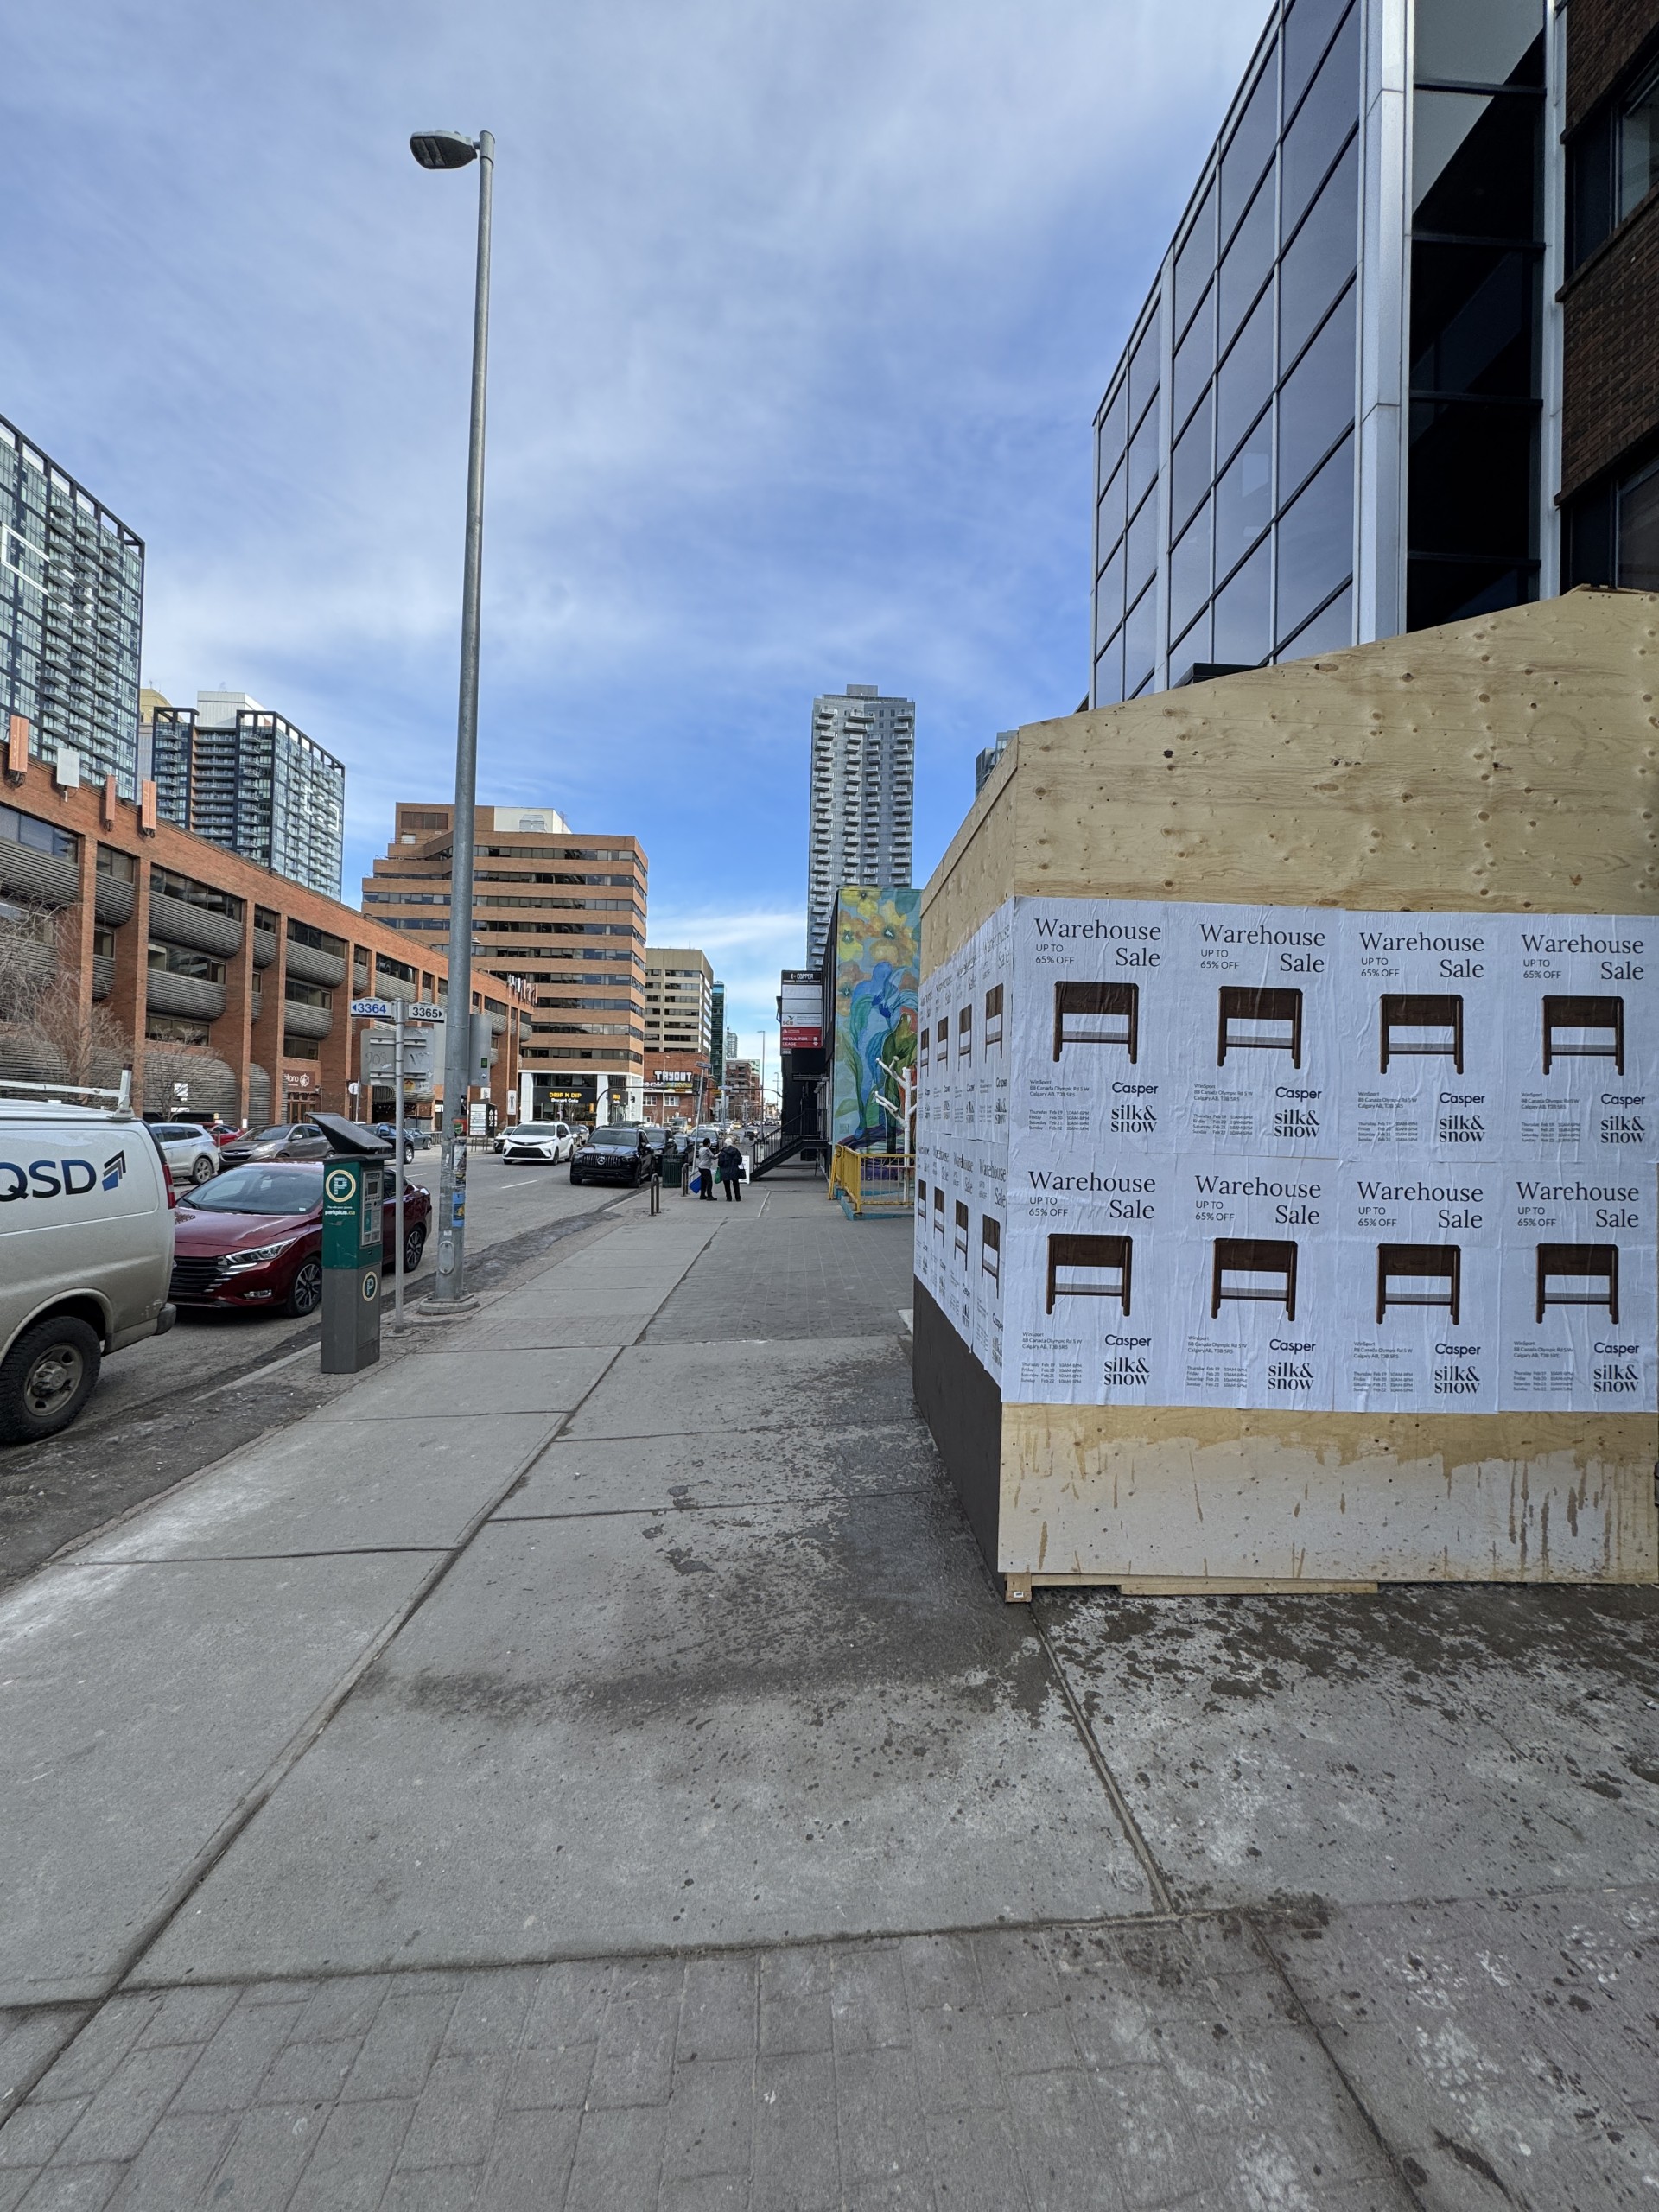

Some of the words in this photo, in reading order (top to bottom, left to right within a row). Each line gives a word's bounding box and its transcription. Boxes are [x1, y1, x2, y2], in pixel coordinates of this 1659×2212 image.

[1034, 918, 1161, 940] Warehouse
[1199, 924, 1325, 946] Warehouse
[1359, 932, 1484, 951] Warehouse
[1521, 934, 1643, 954] Warehouse
[1116, 947, 1160, 967] Sale
[1281, 953, 1324, 973] Sale
[1440, 959, 1484, 978] Sale
[1543, 970, 1561, 979] OFF
[1601, 961, 1643, 980] Sale
[357, 1003, 387, 1014] 3364
[412, 1007, 439, 1019] 3365
[1112, 1082, 1159, 1097] Casper
[1275, 1086, 1322, 1103] Casper
[1440, 1092, 1485, 1107] Casper
[1601, 1094, 1645, 1109] Casper
[1111, 1105, 1157, 1122] silk&
[1274, 1109, 1320, 1127] silk&
[1111, 1118, 1157, 1133] snow
[1274, 1122, 1320, 1137] snow
[1440, 1115, 1484, 1132] silk&
[1601, 1116, 1645, 1131] silk&
[1440, 1128, 1485, 1142] snow
[1601, 1129, 1645, 1143] snow
[0, 1159, 97, 1202] QSD
[1028, 1171, 1155, 1192] Warehouse
[1194, 1175, 1321, 1198] Warehouse
[1357, 1181, 1483, 1202] Warehouse
[1516, 1182, 1639, 1201] Warehouse
[1110, 1199, 1154, 1219] Sale
[1275, 1205, 1319, 1224] Sale
[1439, 1209, 1482, 1228] Sale
[1596, 1209, 1638, 1228] Sale
[1105, 1334, 1152, 1351] Casper
[1269, 1339, 1316, 1355] Casper
[1435, 1343, 1481, 1358] Casper
[1594, 1342, 1639, 1357] Casper
[1104, 1357, 1150, 1375] silk&
[1268, 1362, 1313, 1380] silk&
[1434, 1366, 1480, 1381] silk&
[1594, 1364, 1638, 1380] silk&
[1104, 1371, 1150, 1385] snow
[1268, 1376, 1313, 1391] snow
[1594, 1378, 1638, 1392] snow
[1434, 1380, 1480, 1394] snow
